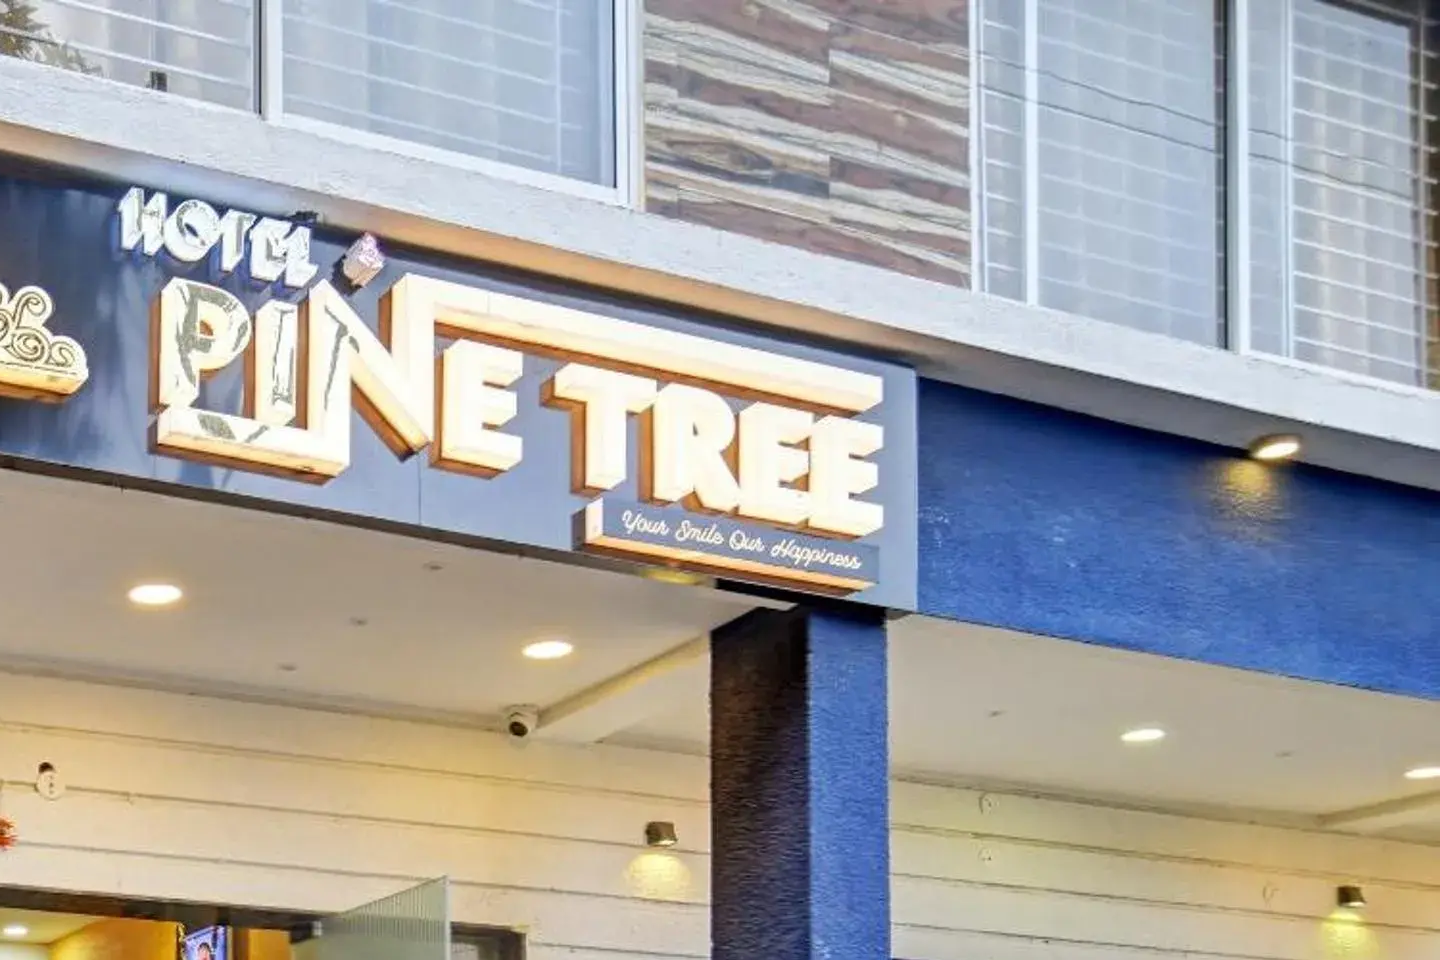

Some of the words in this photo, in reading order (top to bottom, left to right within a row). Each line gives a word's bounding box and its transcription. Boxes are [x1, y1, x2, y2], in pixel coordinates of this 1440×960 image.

[116, 186, 319, 290] HOTEL
[148, 271, 524, 484] PINE
[541, 362, 884, 543] TREE
[621, 509, 670, 537] Your
[675, 519, 725, 546] Smile
[729, 529, 766, 552] Our
[770, 539, 863, 570] Happiness
